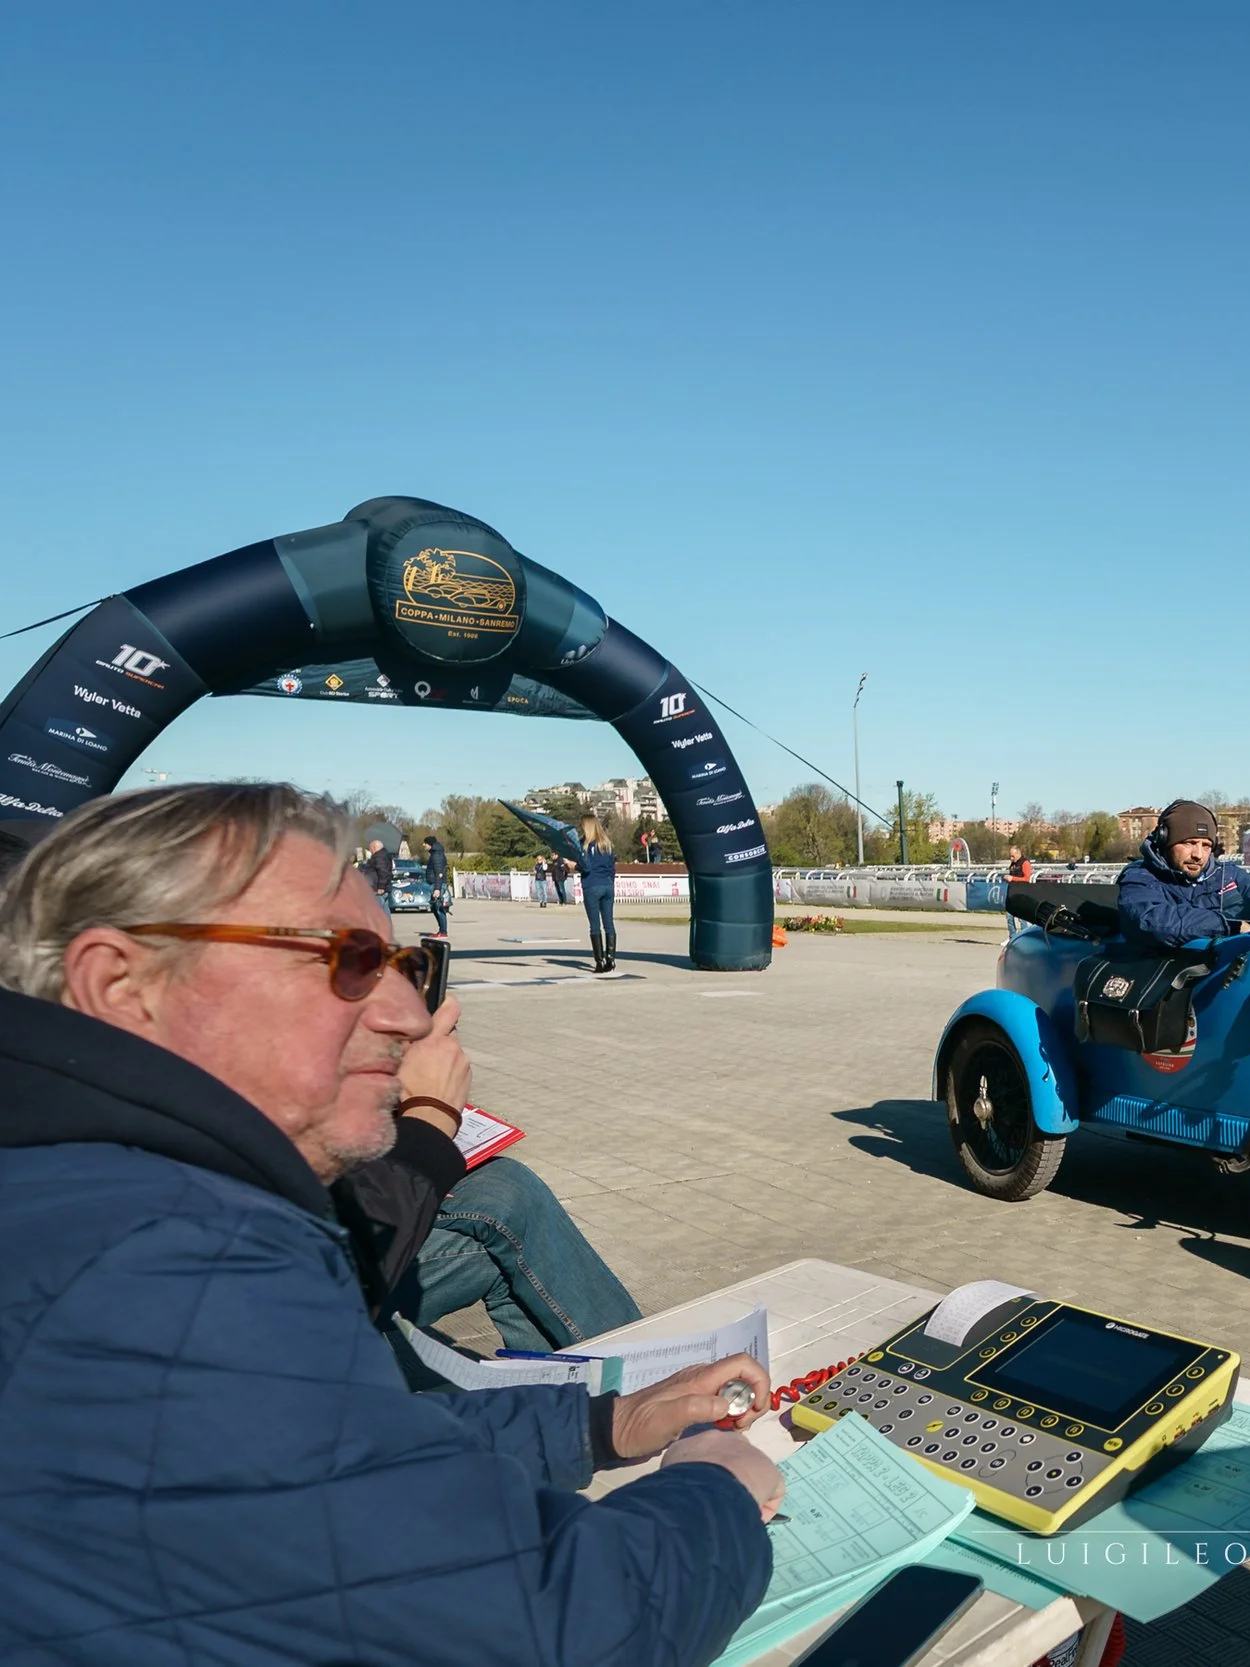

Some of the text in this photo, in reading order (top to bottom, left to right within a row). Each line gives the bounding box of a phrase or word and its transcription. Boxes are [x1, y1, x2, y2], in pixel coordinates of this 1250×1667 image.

[400, 607, 515, 628] COPPA MILANO SANREMO
[111, 643, 163, 677] 10
[73, 684, 142, 719] Wyler Vetta
[507, 696, 529, 704] EPOCA
[660, 693, 685, 718] 10
[48, 727, 108, 752] MARINA DI LOANO
[671, 732, 713, 749] Wyler Vetta
[1113, 1325, 1150, 1340] MICROGATE
